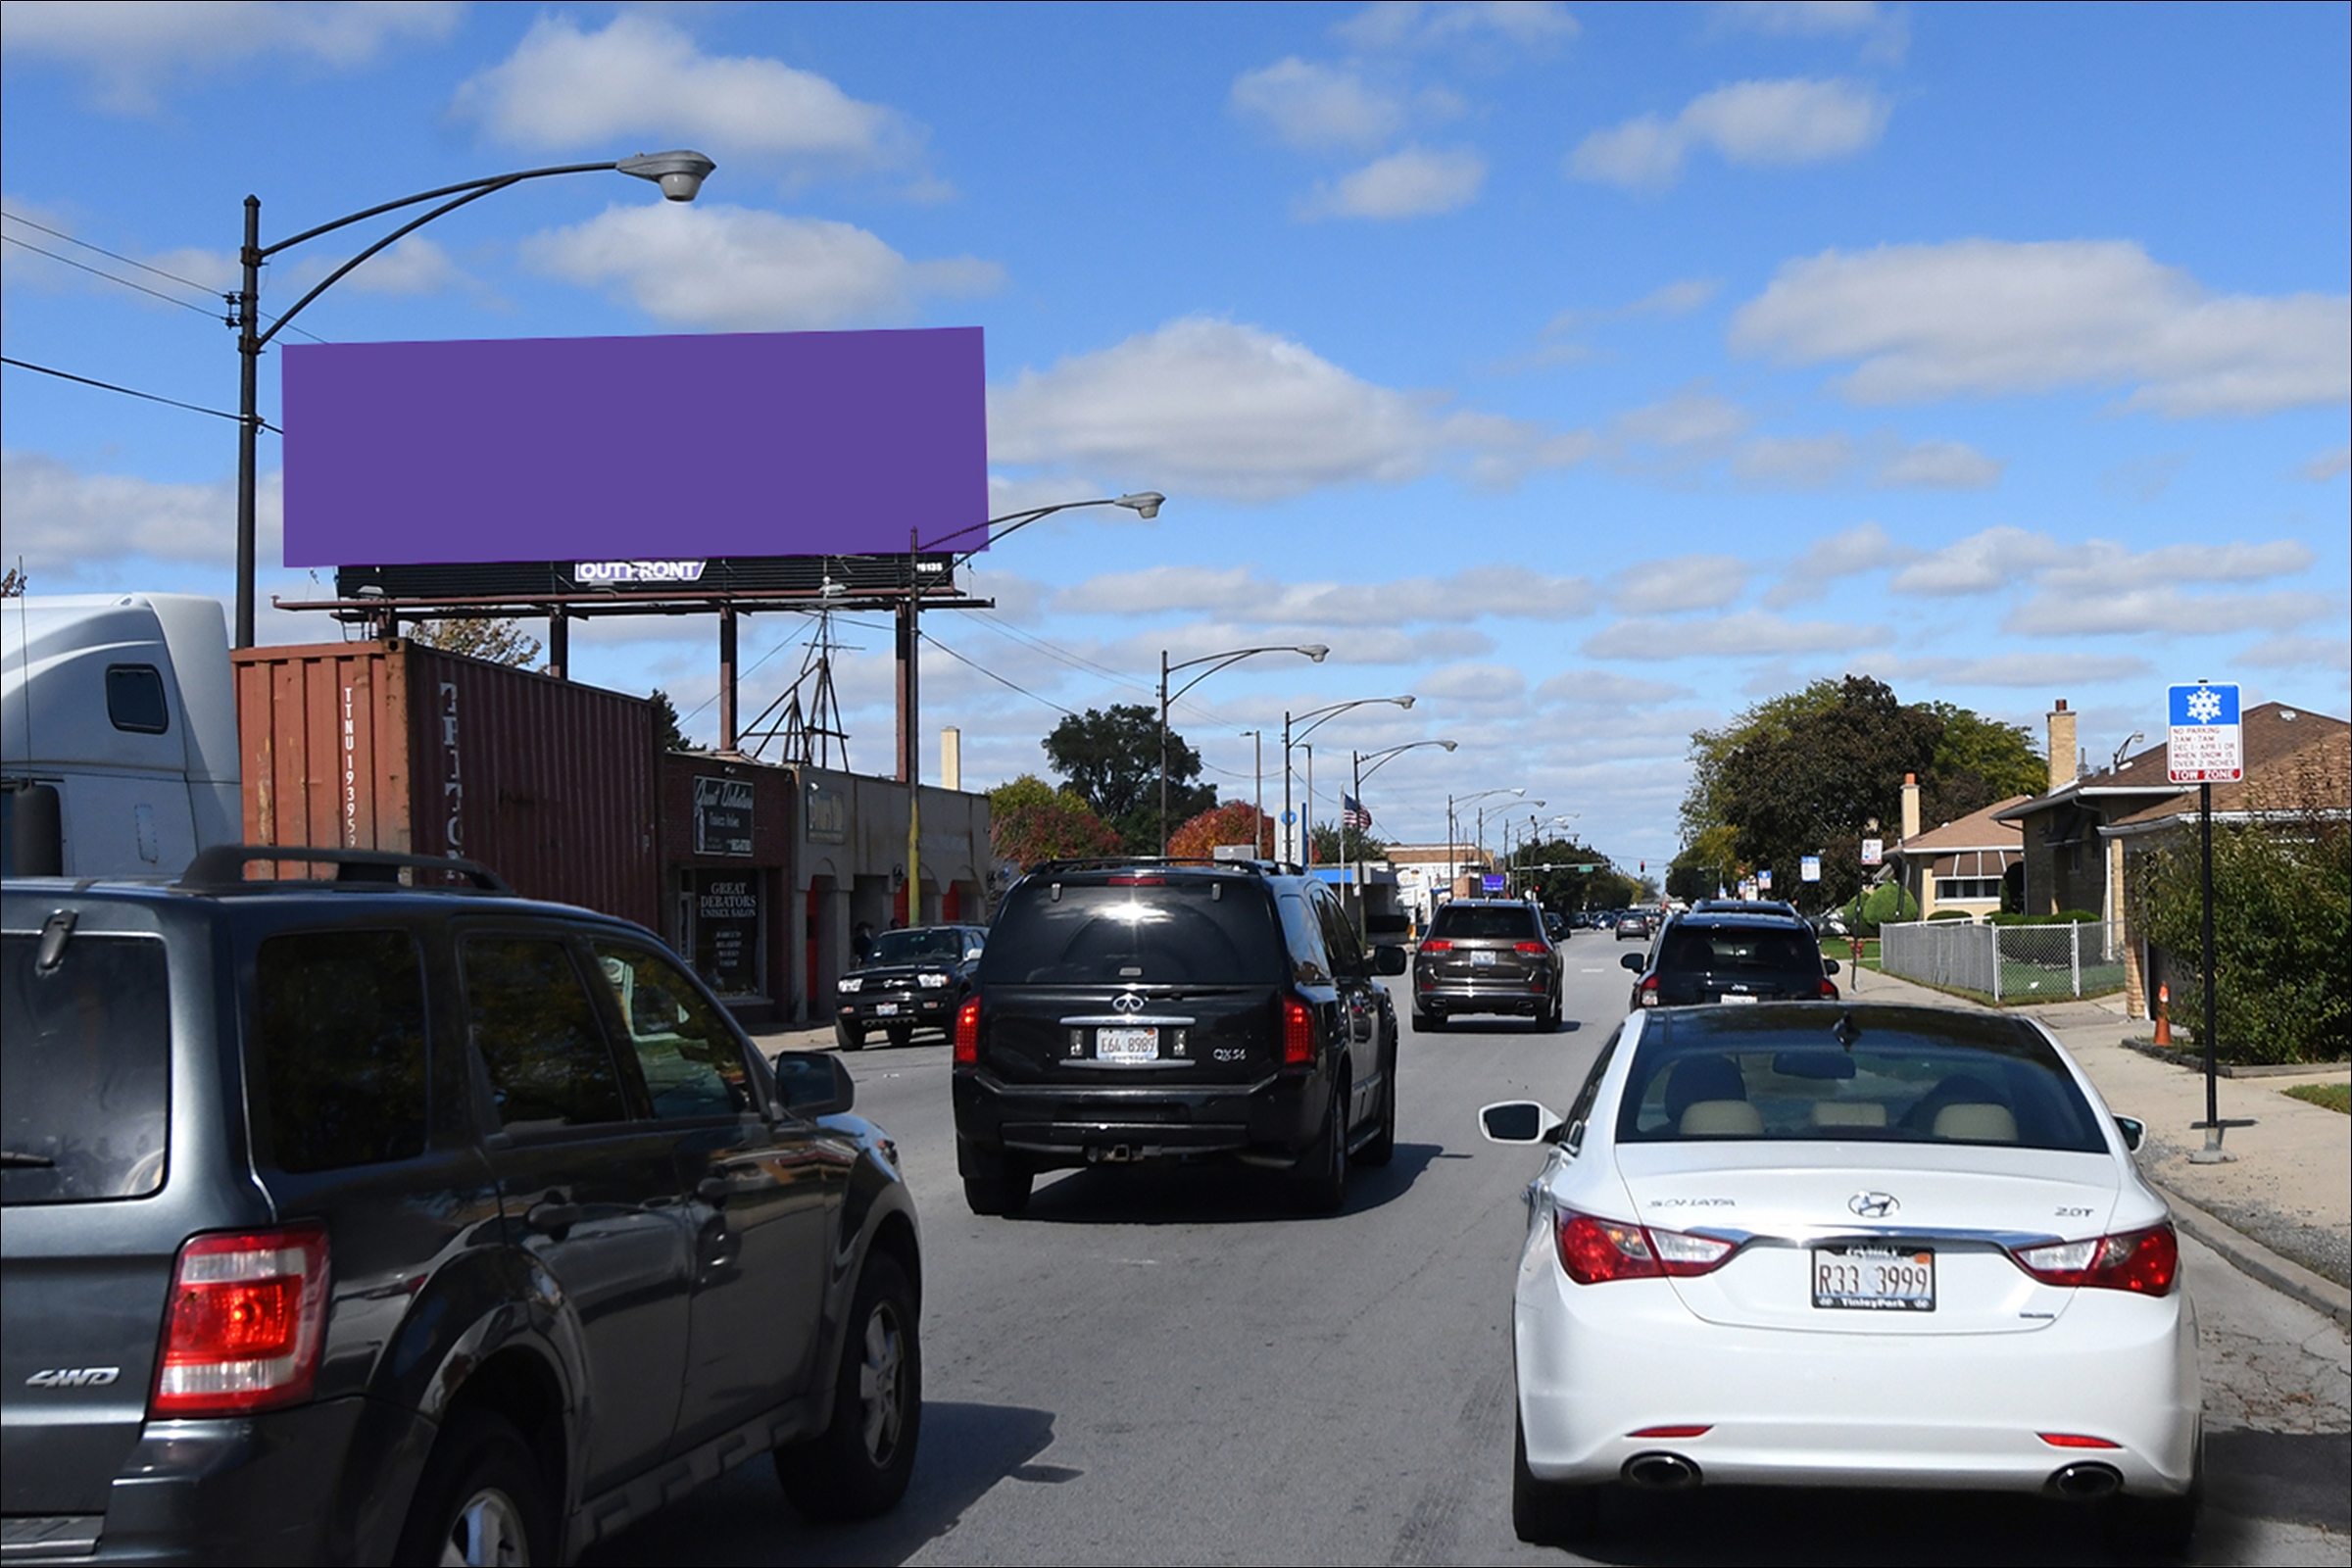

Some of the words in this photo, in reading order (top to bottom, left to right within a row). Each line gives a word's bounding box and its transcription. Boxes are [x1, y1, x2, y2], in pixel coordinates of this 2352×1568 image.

[580, 562, 700, 578] OUTFRONT
[2174, 770, 2198, 780] TOW
[2204, 769, 2233, 780] ZONE
[710, 882, 746, 895] GREAT
[701, 896, 757, 908] DEBATORS
[701, 908, 729, 917] UNISEX
[731, 908, 756, 917] SALON
[1101, 1037, 1121, 1053] E64
[1128, 1037, 1154, 1053] 8989
[1213, 1048, 1247, 1061] QX56
[1647, 1198, 1737, 1208] SONATA
[1819, 1264, 1859, 1295] R33
[1876, 1265, 1927, 1297] 3999
[25, 1367, 120, 1388] 4WD
